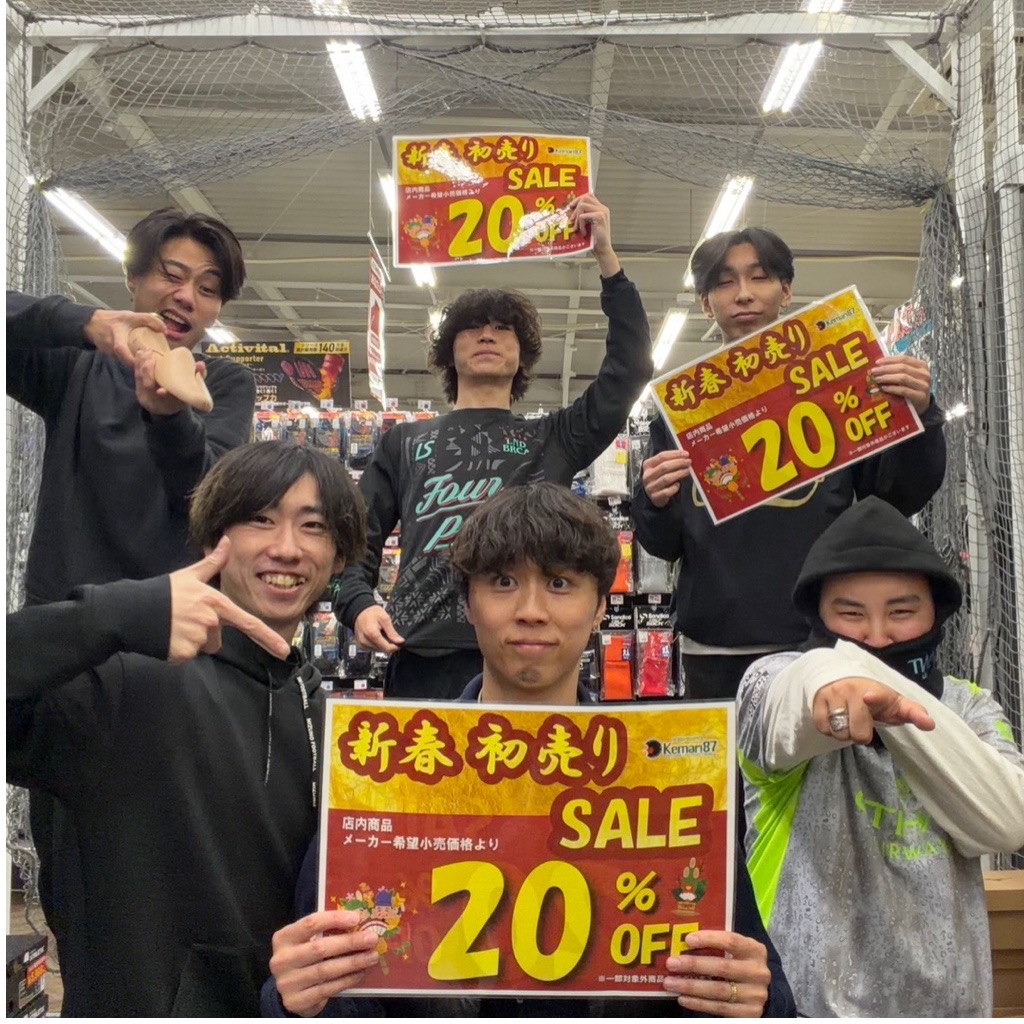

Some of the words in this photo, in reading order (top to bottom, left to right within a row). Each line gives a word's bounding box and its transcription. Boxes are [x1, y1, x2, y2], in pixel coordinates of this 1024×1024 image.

[406, 139, 536, 167] 新初売り
[508, 167, 576, 191] SALE
[448, 195, 525, 257] 20
[206, 343, 289, 353] Activital
[789, 336, 869, 395] SALE
[833, 385, 859, 413] %
[845, 402, 892, 443] OFF
[741, 400, 836, 492] 20
[663, 740, 717, 755] Kemari87
[342, 816, 393, 832] 店内商品
[342, 834, 500, 852] メーカー希望小売価格より
[560, 796, 703, 850] SALE
[616, 871, 657, 912] %
[427, 859, 592, 982] 20
[610, 922, 699, 966] OFF
